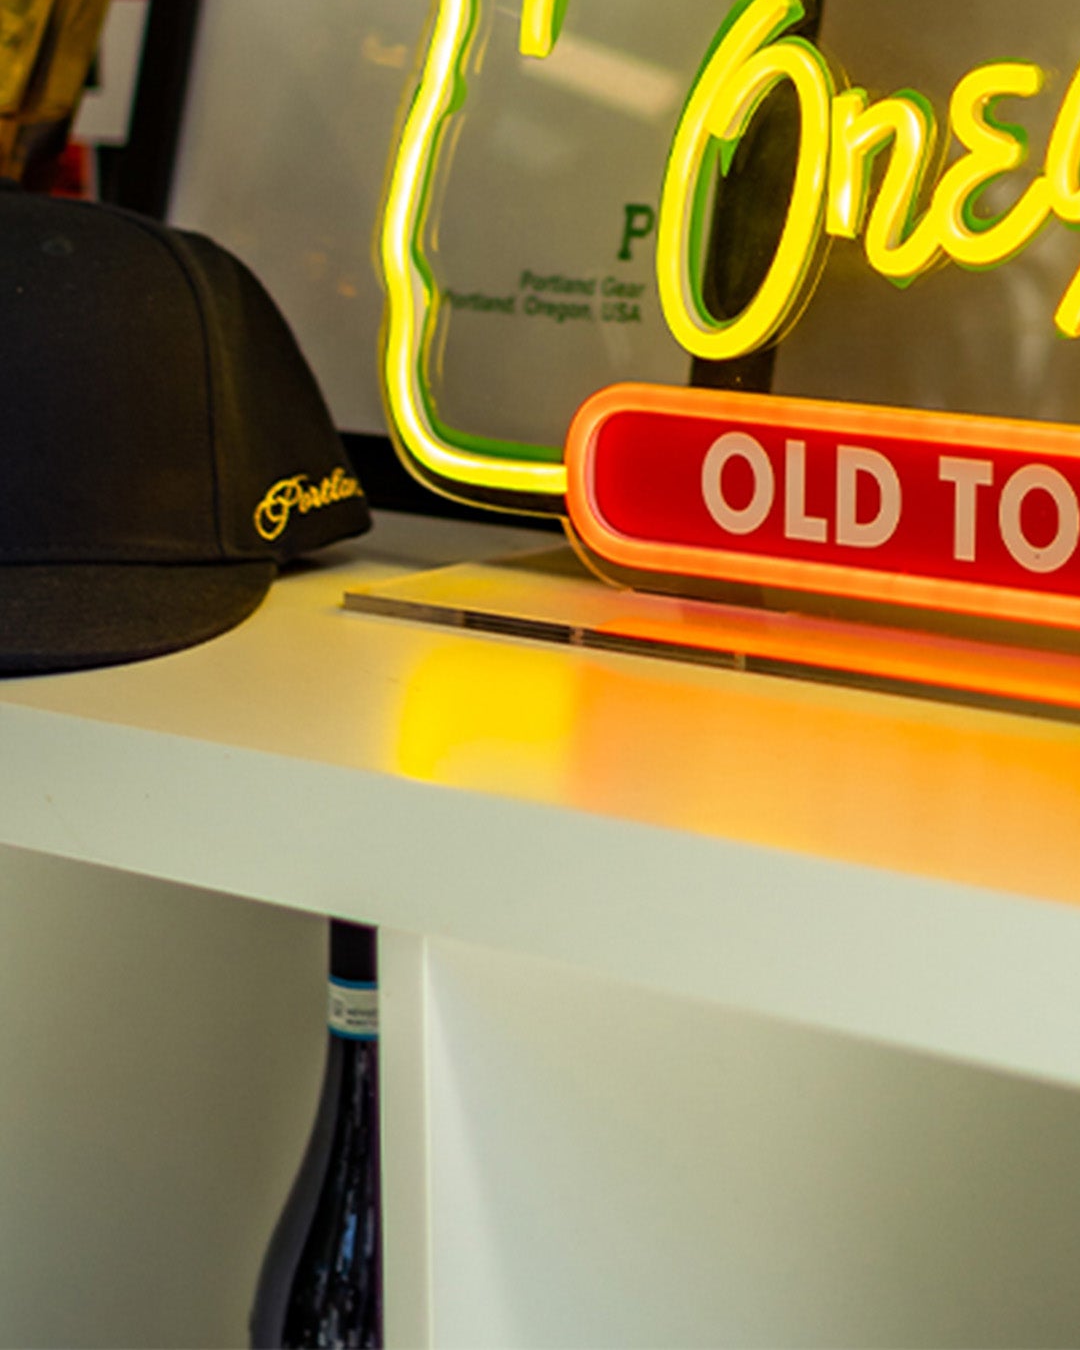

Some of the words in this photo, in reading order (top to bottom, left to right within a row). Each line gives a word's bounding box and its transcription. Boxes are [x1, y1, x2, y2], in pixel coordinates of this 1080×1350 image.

[519, 269, 596, 296] Portland
[601, 276, 645, 298] Gear
[601, 302, 642, 324] USA
[701, 431, 901, 549] OLD
